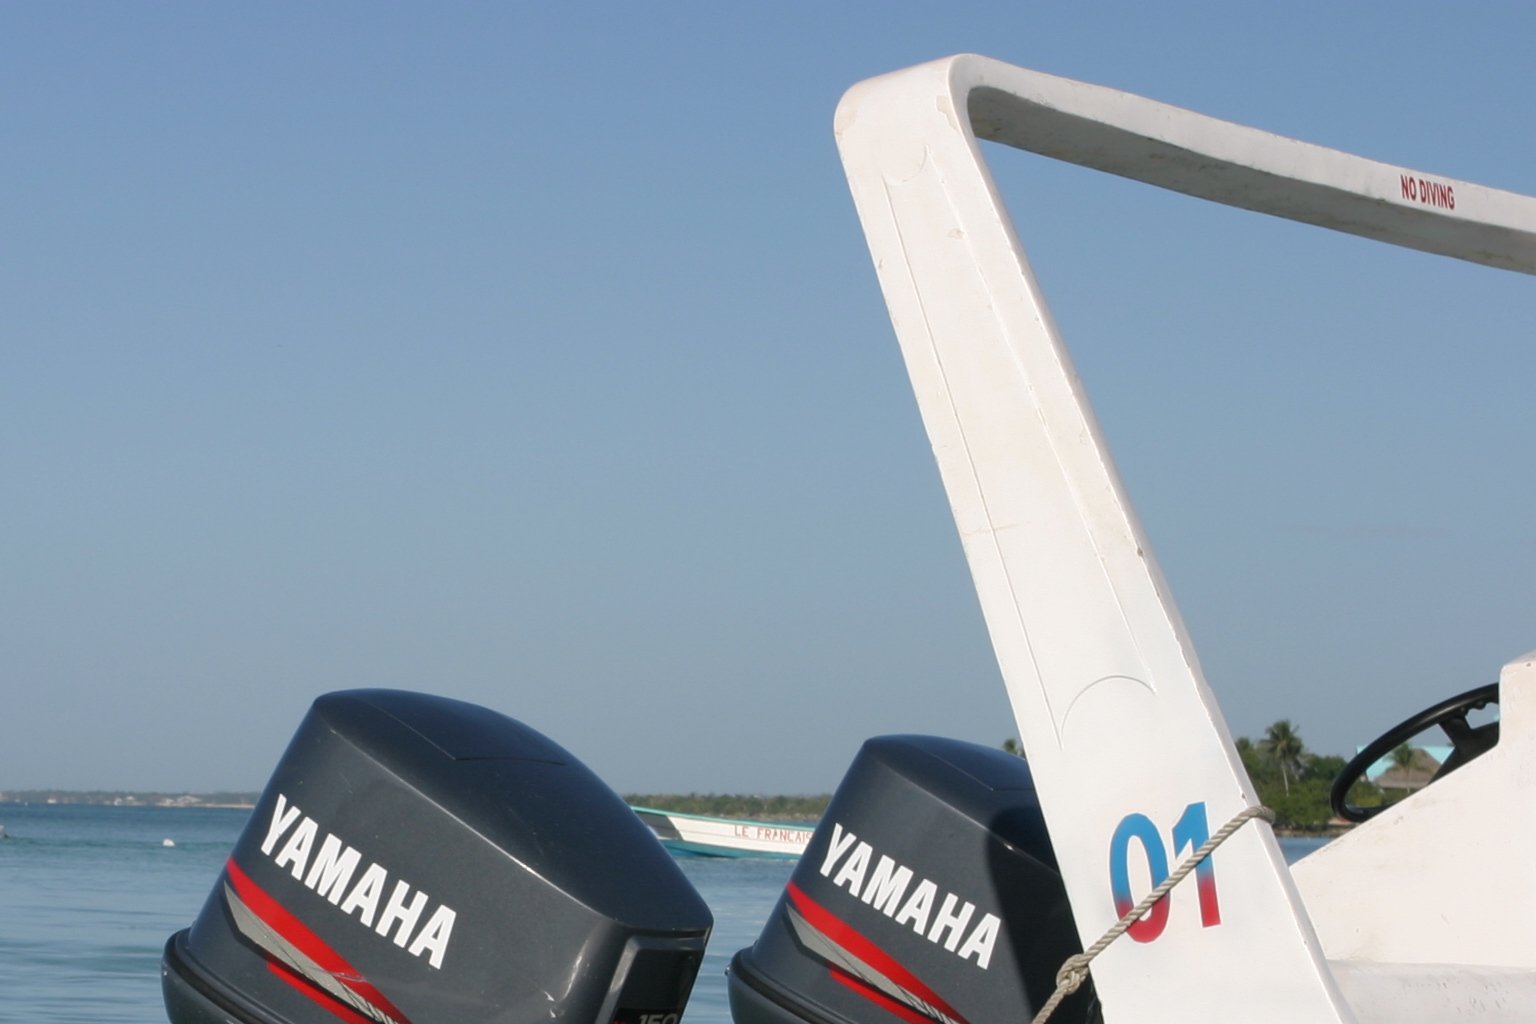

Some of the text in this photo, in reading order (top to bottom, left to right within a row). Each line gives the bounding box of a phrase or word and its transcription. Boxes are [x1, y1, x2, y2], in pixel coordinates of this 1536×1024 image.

[1400, 174, 1456, 210] NO DIVING
[260, 793, 458, 970] YAMAHA
[734, 824, 750, 838] LE
[818, 823, 1001, 970] YAMAHA
[1109, 800, 1222, 944] 01
